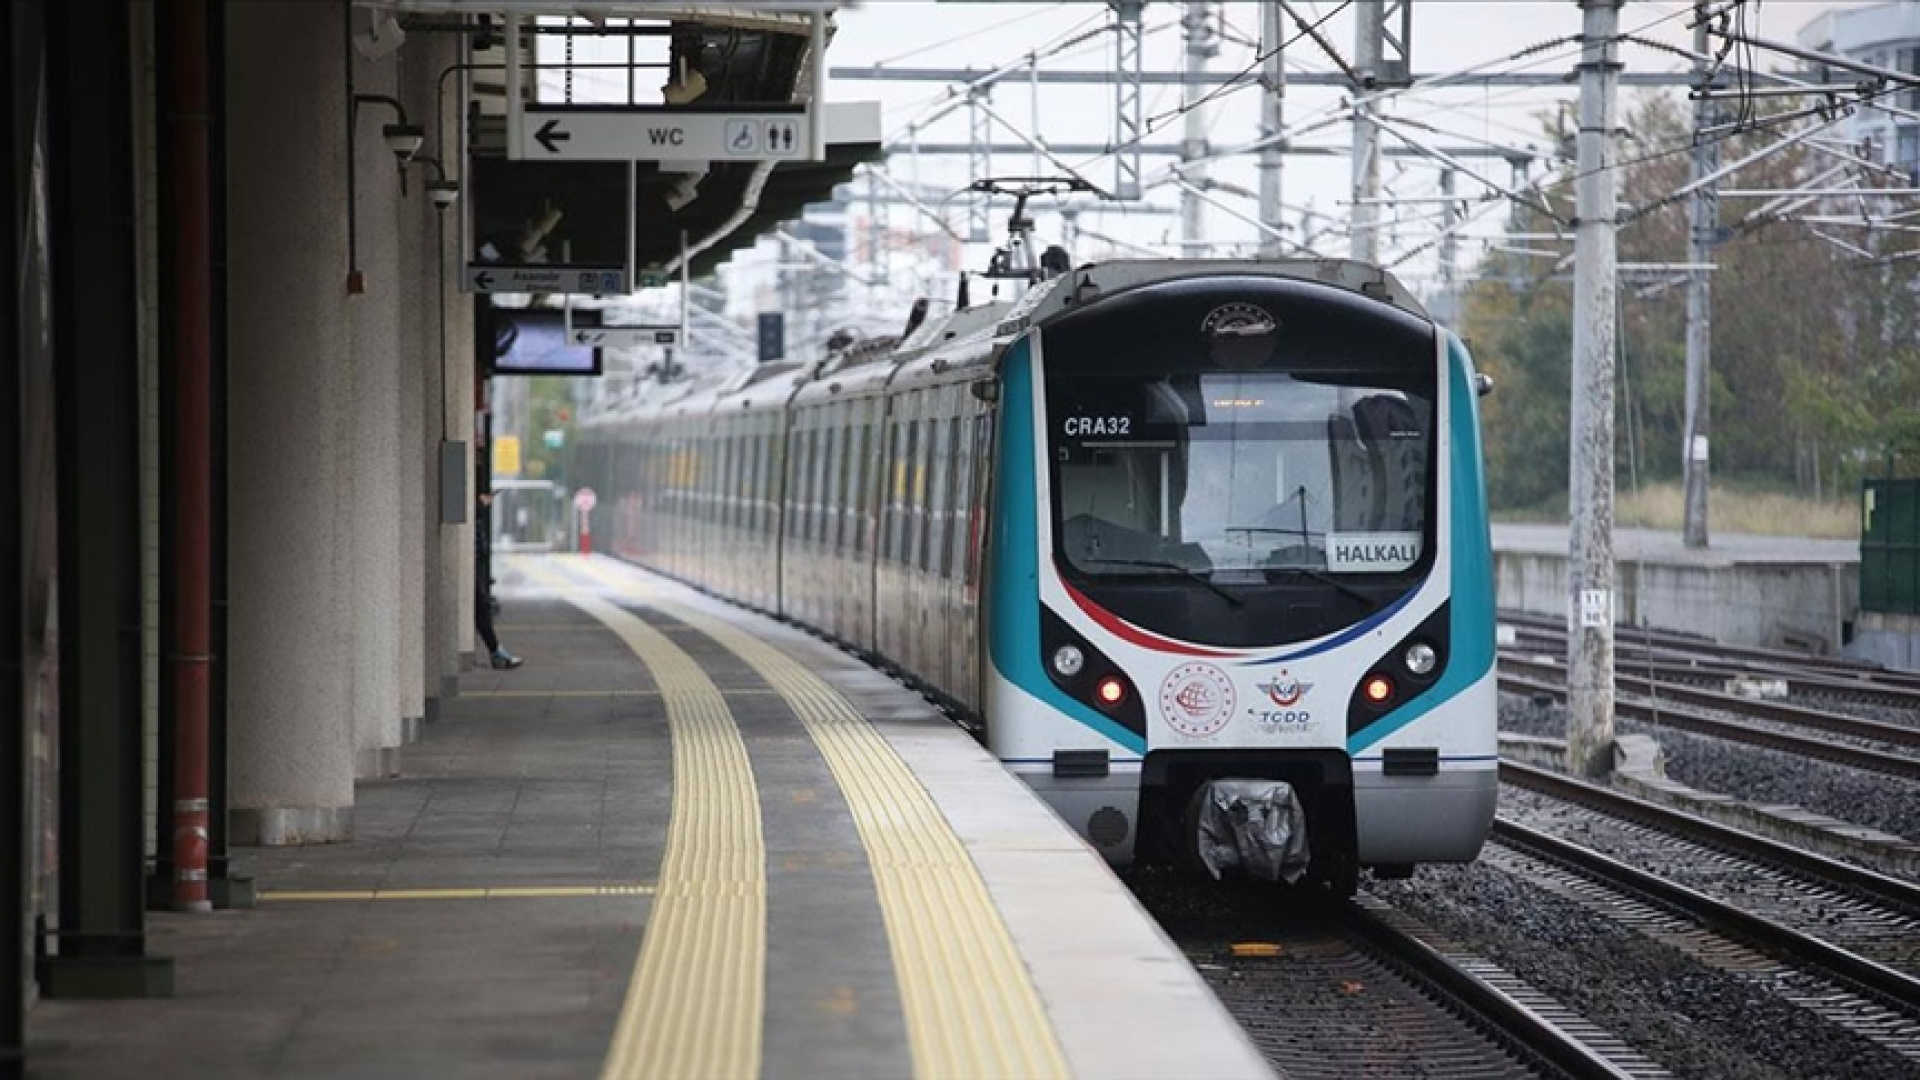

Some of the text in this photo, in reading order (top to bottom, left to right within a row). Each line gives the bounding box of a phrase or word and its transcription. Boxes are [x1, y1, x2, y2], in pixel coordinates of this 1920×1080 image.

[647, 128, 684, 146] WC
[1065, 417, 1130, 435] CRA32
[1336, 545, 1416, 562] HALKALI
[1260, 711, 1310, 723] TCDD
